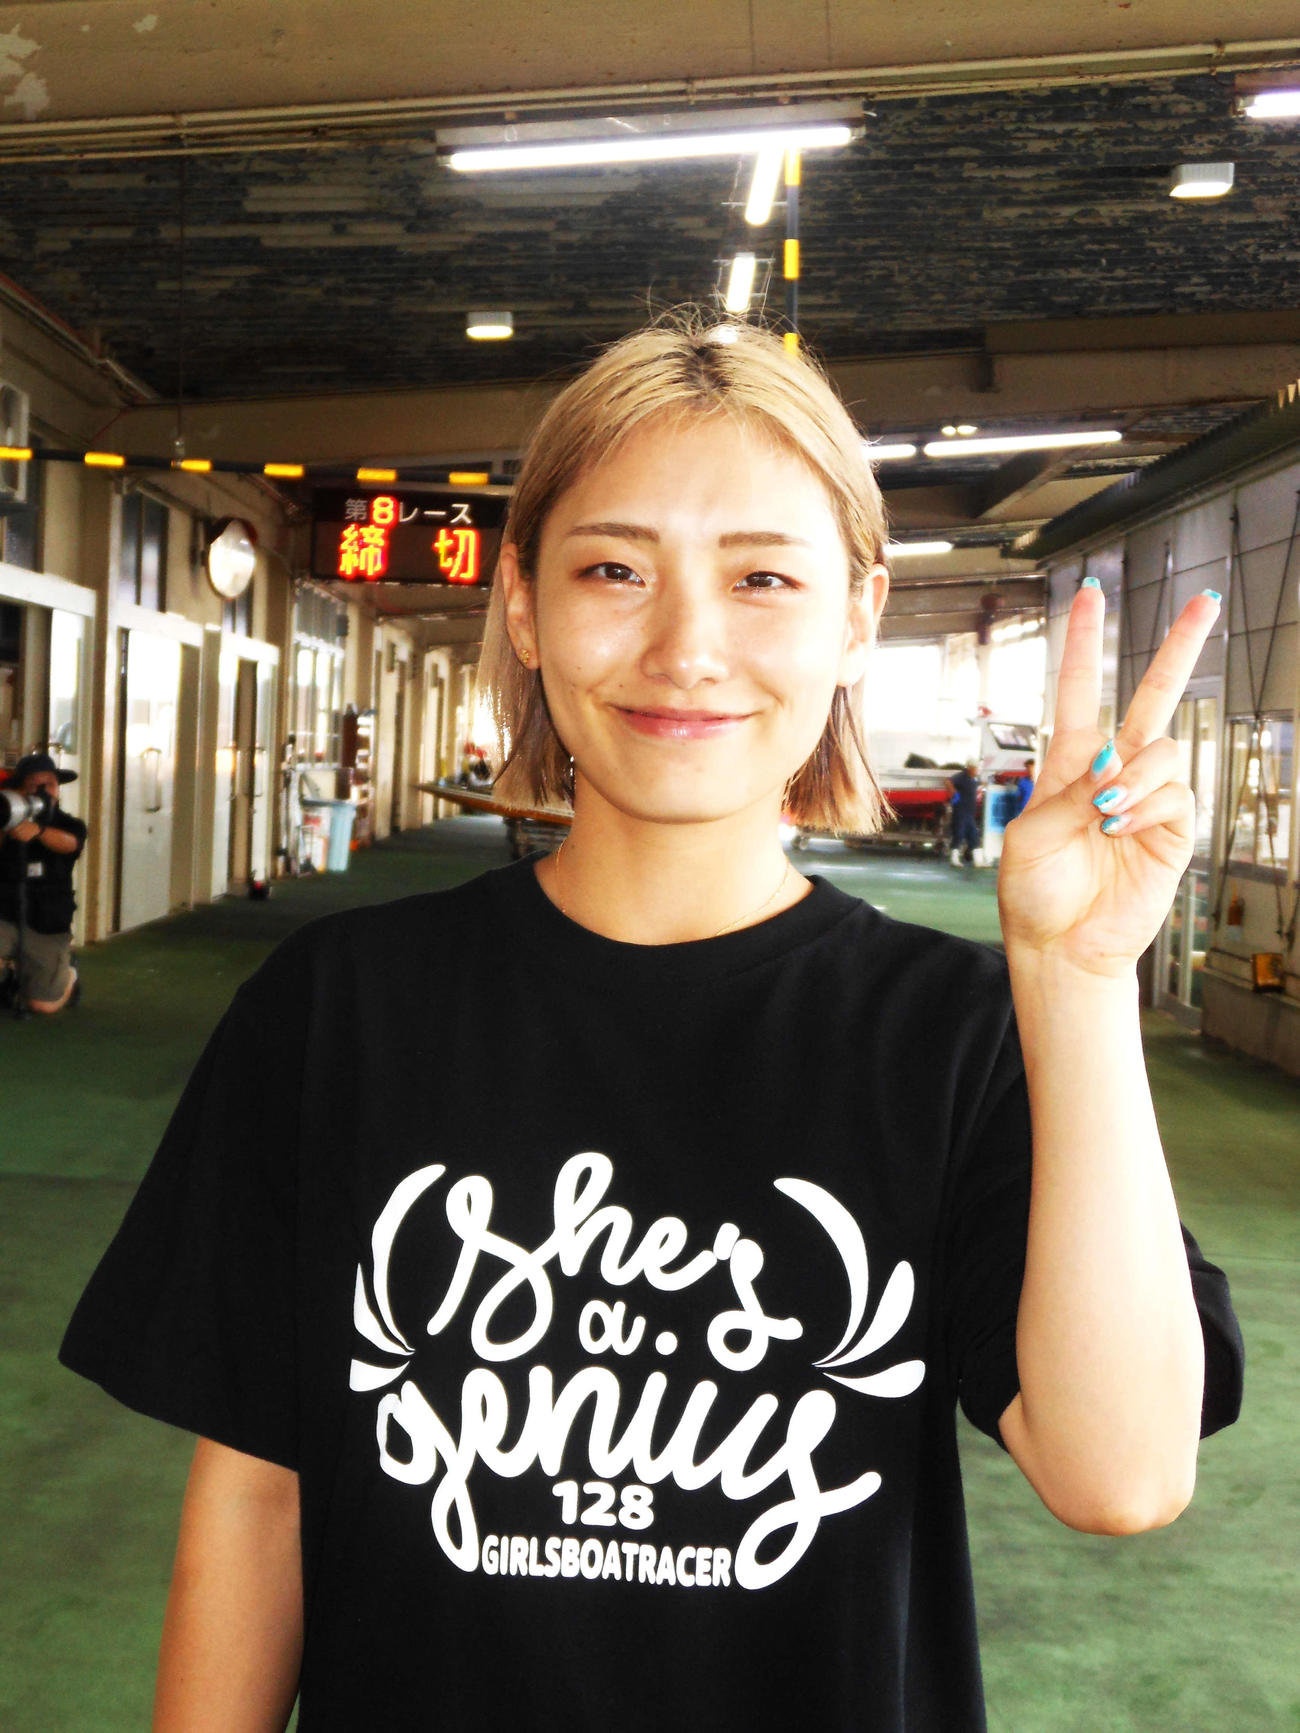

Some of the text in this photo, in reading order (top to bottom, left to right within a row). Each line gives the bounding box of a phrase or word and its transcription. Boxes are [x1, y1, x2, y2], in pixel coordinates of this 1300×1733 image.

[376, 1332, 882, 1590] genius
[552, 1480, 654, 1530] 128
[482, 1535, 731, 1587] GIRLSBOATRACER
